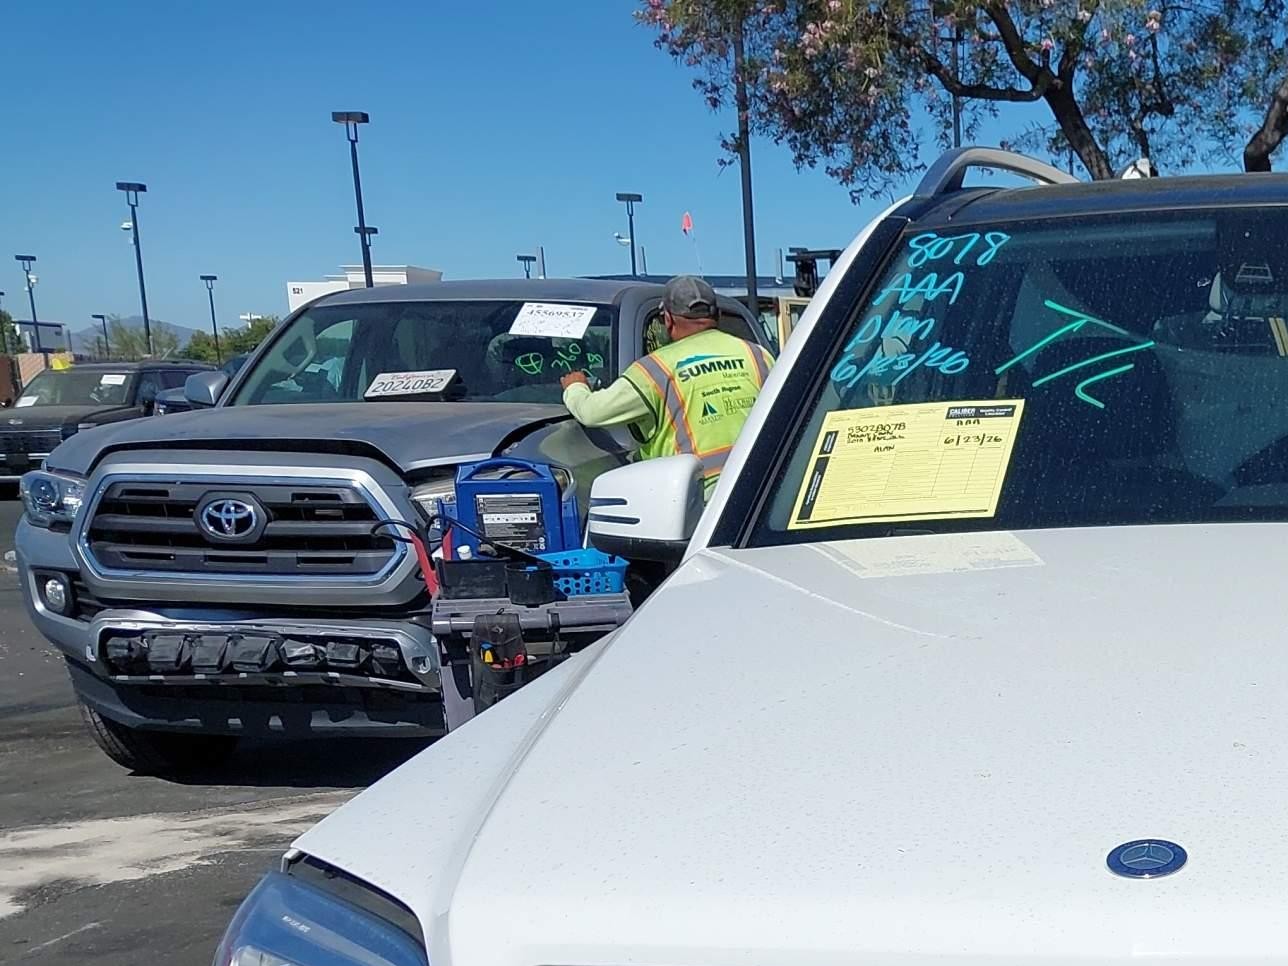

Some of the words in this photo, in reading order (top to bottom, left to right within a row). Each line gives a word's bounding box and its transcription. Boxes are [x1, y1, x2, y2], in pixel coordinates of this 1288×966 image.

[908, 232, 1011, 267] 8078
[873, 271, 964, 305] AAA
[678, 359, 745, 382] SUMMIT
[830, 342, 969, 388] 6/23/26
[371, 378, 444, 393] 20240B2
